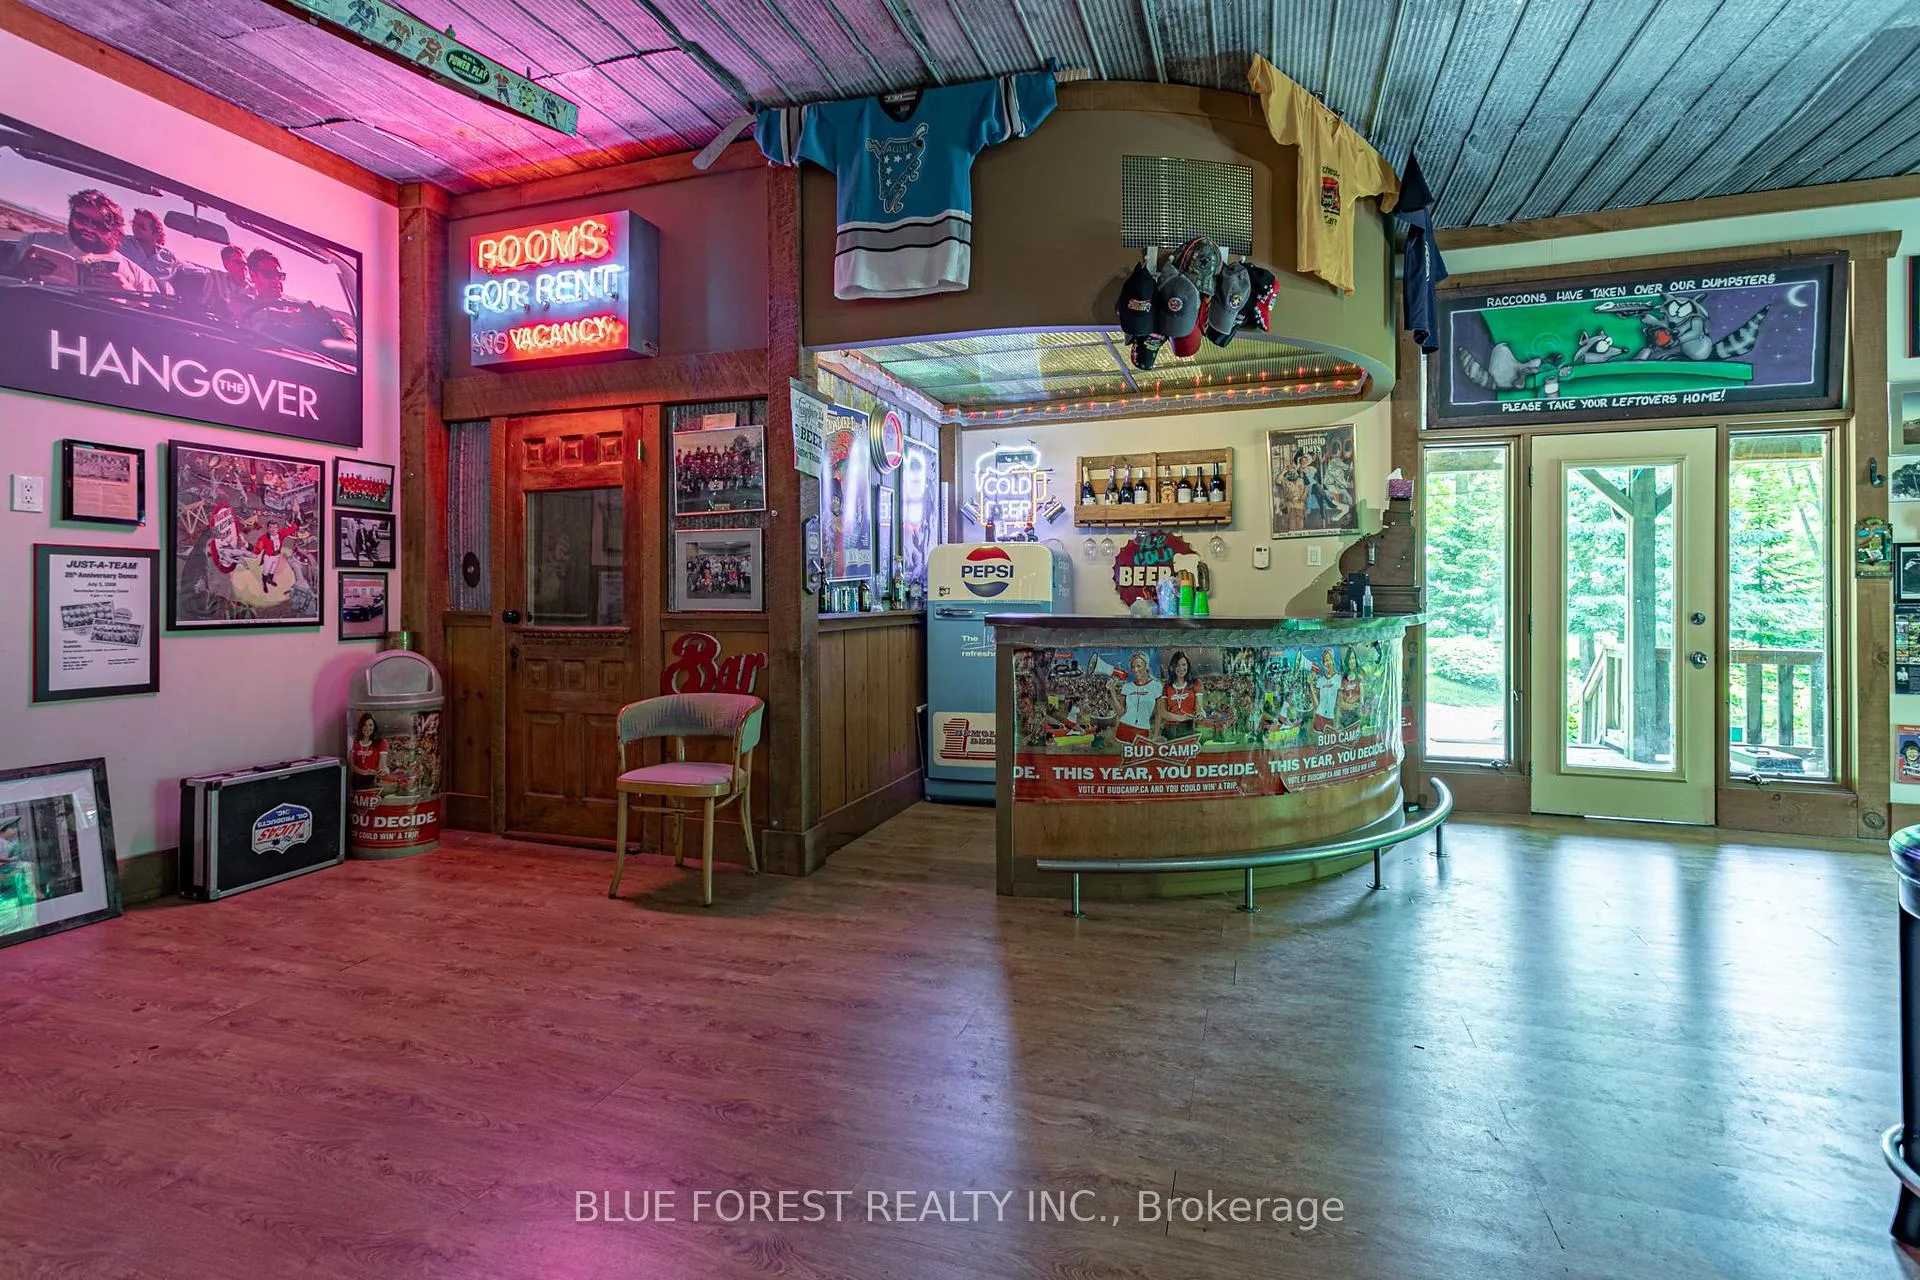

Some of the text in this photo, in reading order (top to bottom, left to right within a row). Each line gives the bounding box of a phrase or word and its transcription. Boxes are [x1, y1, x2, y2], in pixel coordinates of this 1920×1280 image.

[448, 54, 472, 72] POWER
[470, 64, 489, 81] PLAY
[478, 219, 602, 270] ROOMS
[464, 264, 625, 318] FOR RENT
[1486, 273, 1776, 307] RACCOONS HAVE TAKEN OVER OUR DUMPSTERS
[509, 315, 618, 351] VACANCY
[50, 329, 320, 421] HANGOVER
[218, 379, 245, 394] THE
[1502, 388, 1726, 413] PLEASE TAKE YOUR LEFTOVERS HOME!
[801, 427, 823, 450] BEER
[1297, 436, 1326, 448] Buffalo
[984, 477, 1032, 495] COLD
[66, 560, 138, 570] JUST-A-TEAM
[1133, 547, 1174, 566] COLD
[78, 572, 116, 580] Anniversary
[961, 565, 1014, 578] PEPSI
[662, 632, 769, 694] Bar
[1318, 729, 1360, 747] BUD CAMP
[1123, 743, 1199, 757] BUD CAMP
[1268, 759, 1299, 773] THIS
[1303, 753, 1335, 768] YEAR,
[1337, 751, 1356, 764] YOU
[1053, 763, 1258, 782] THIS YEAR, YOU DECIDE.
[1287, 775, 1300, 785] VOTE
[1078, 785, 1095, 794] VOTE
[1097, 785, 1105, 793] AT
[1107, 784, 1149, 794] BUDCAMP.CA
[1150, 784, 1164, 793] AND
[1165, 784, 1179, 793] YOU
[1180, 783, 1200, 792] COULD
[1223, 781, 1238, 790] TRIP.
[353, 795, 379, 807] AMP
[257, 815, 295, 828] PRODUCTS
[352, 811, 437, 828] OU DECIDE.
[257, 821, 304, 841] LUCAS
[359, 831, 378, 840] COULD
[398, 832, 402, 840] A
